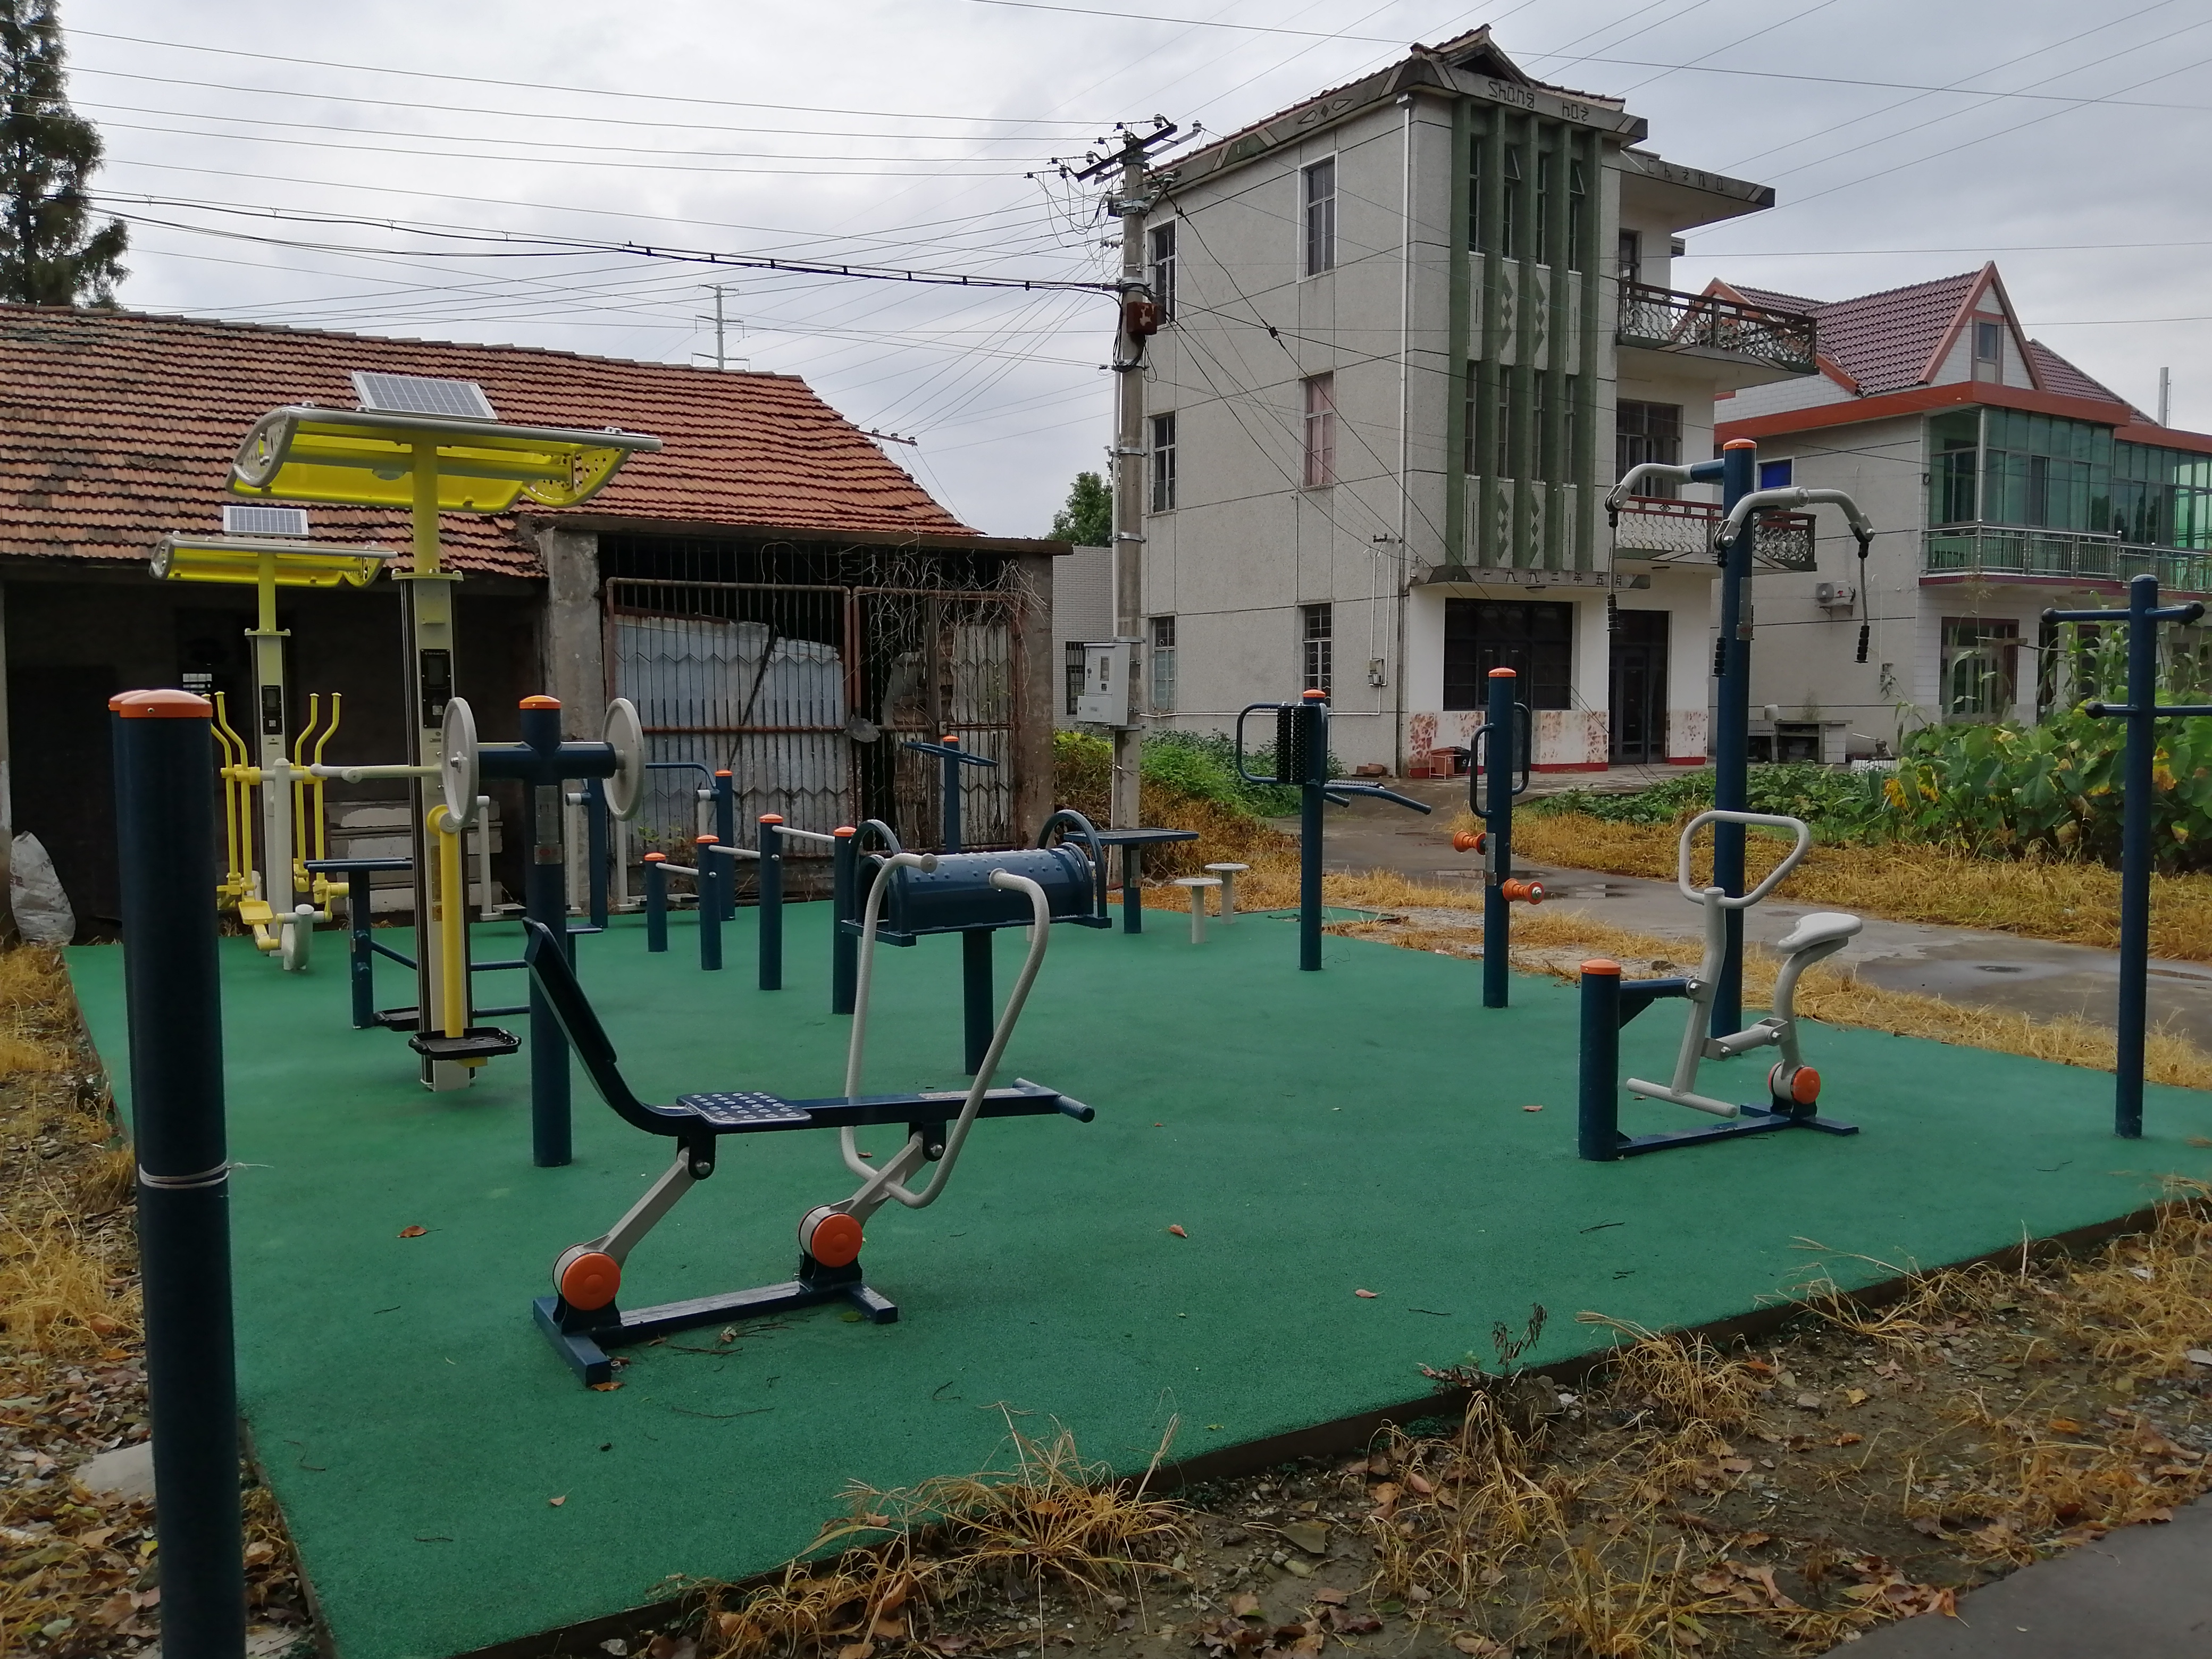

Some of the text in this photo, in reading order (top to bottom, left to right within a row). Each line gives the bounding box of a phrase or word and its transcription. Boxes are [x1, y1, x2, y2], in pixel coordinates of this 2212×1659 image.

[1483, 569, 1621, 586] 一九九二年五月
